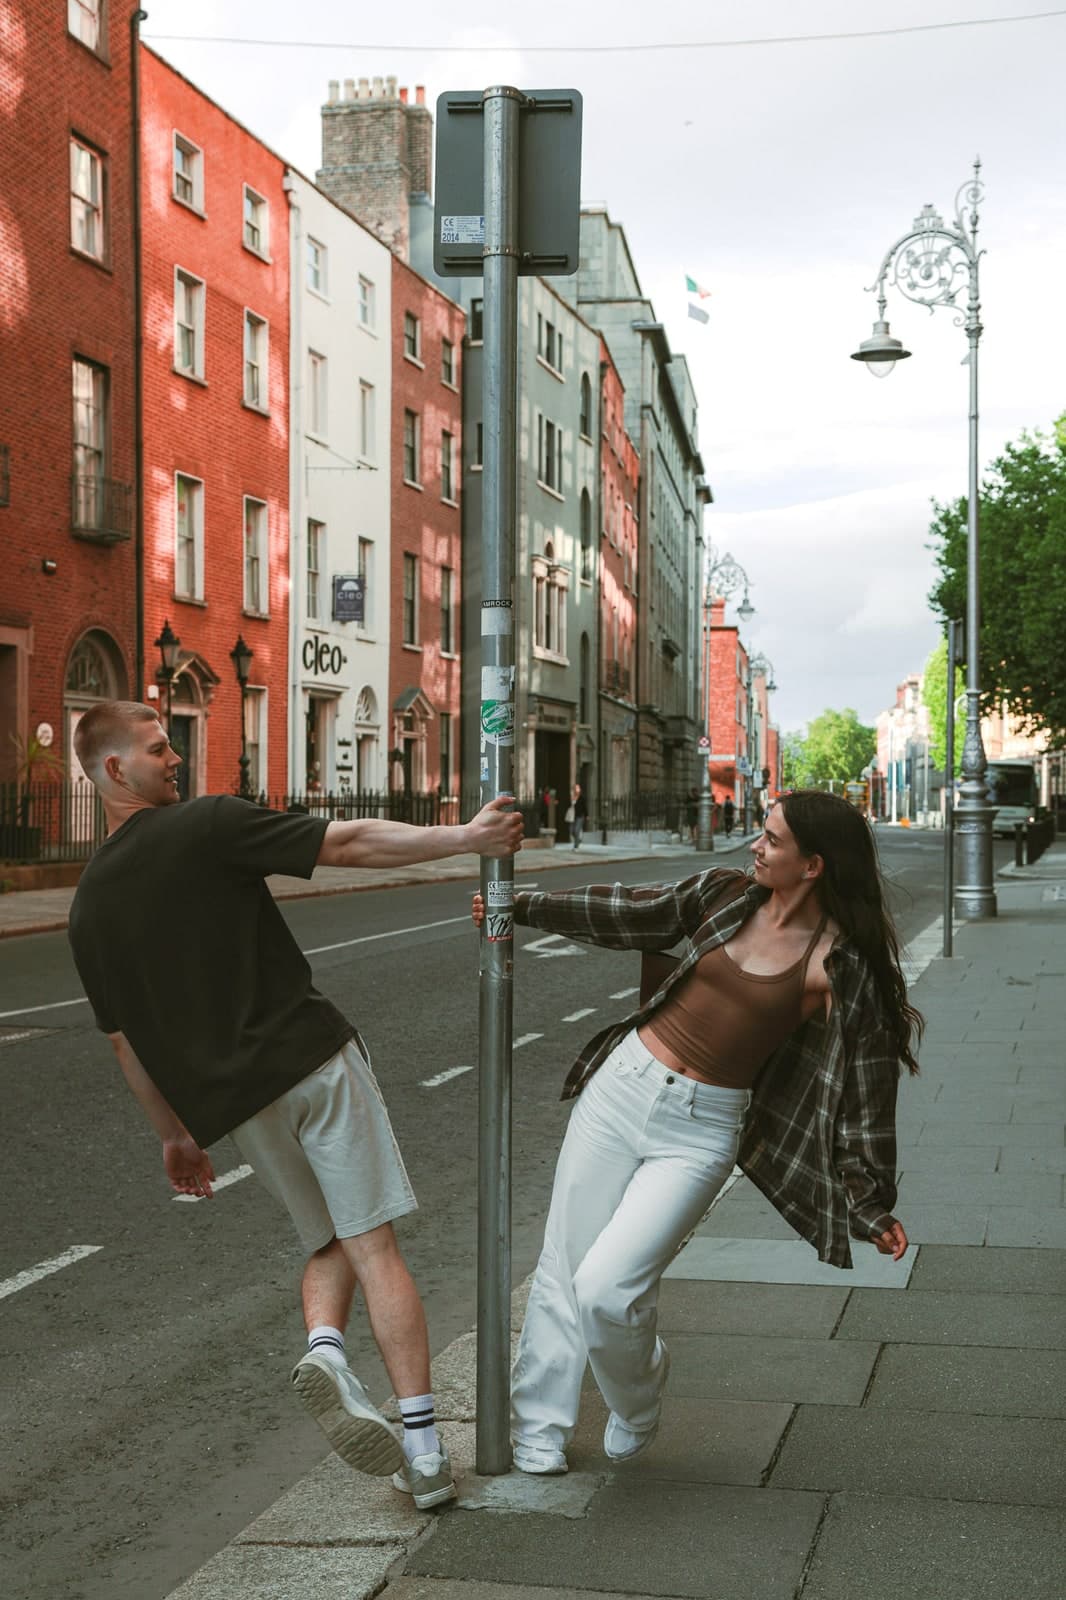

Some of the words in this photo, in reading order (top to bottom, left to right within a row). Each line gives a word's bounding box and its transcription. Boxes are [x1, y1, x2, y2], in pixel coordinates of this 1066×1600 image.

[443, 217, 454, 227] CE
[442, 232, 459, 242] 2014
[337, 591, 363, 600] cleo
[303, 635, 342, 676] cleo
